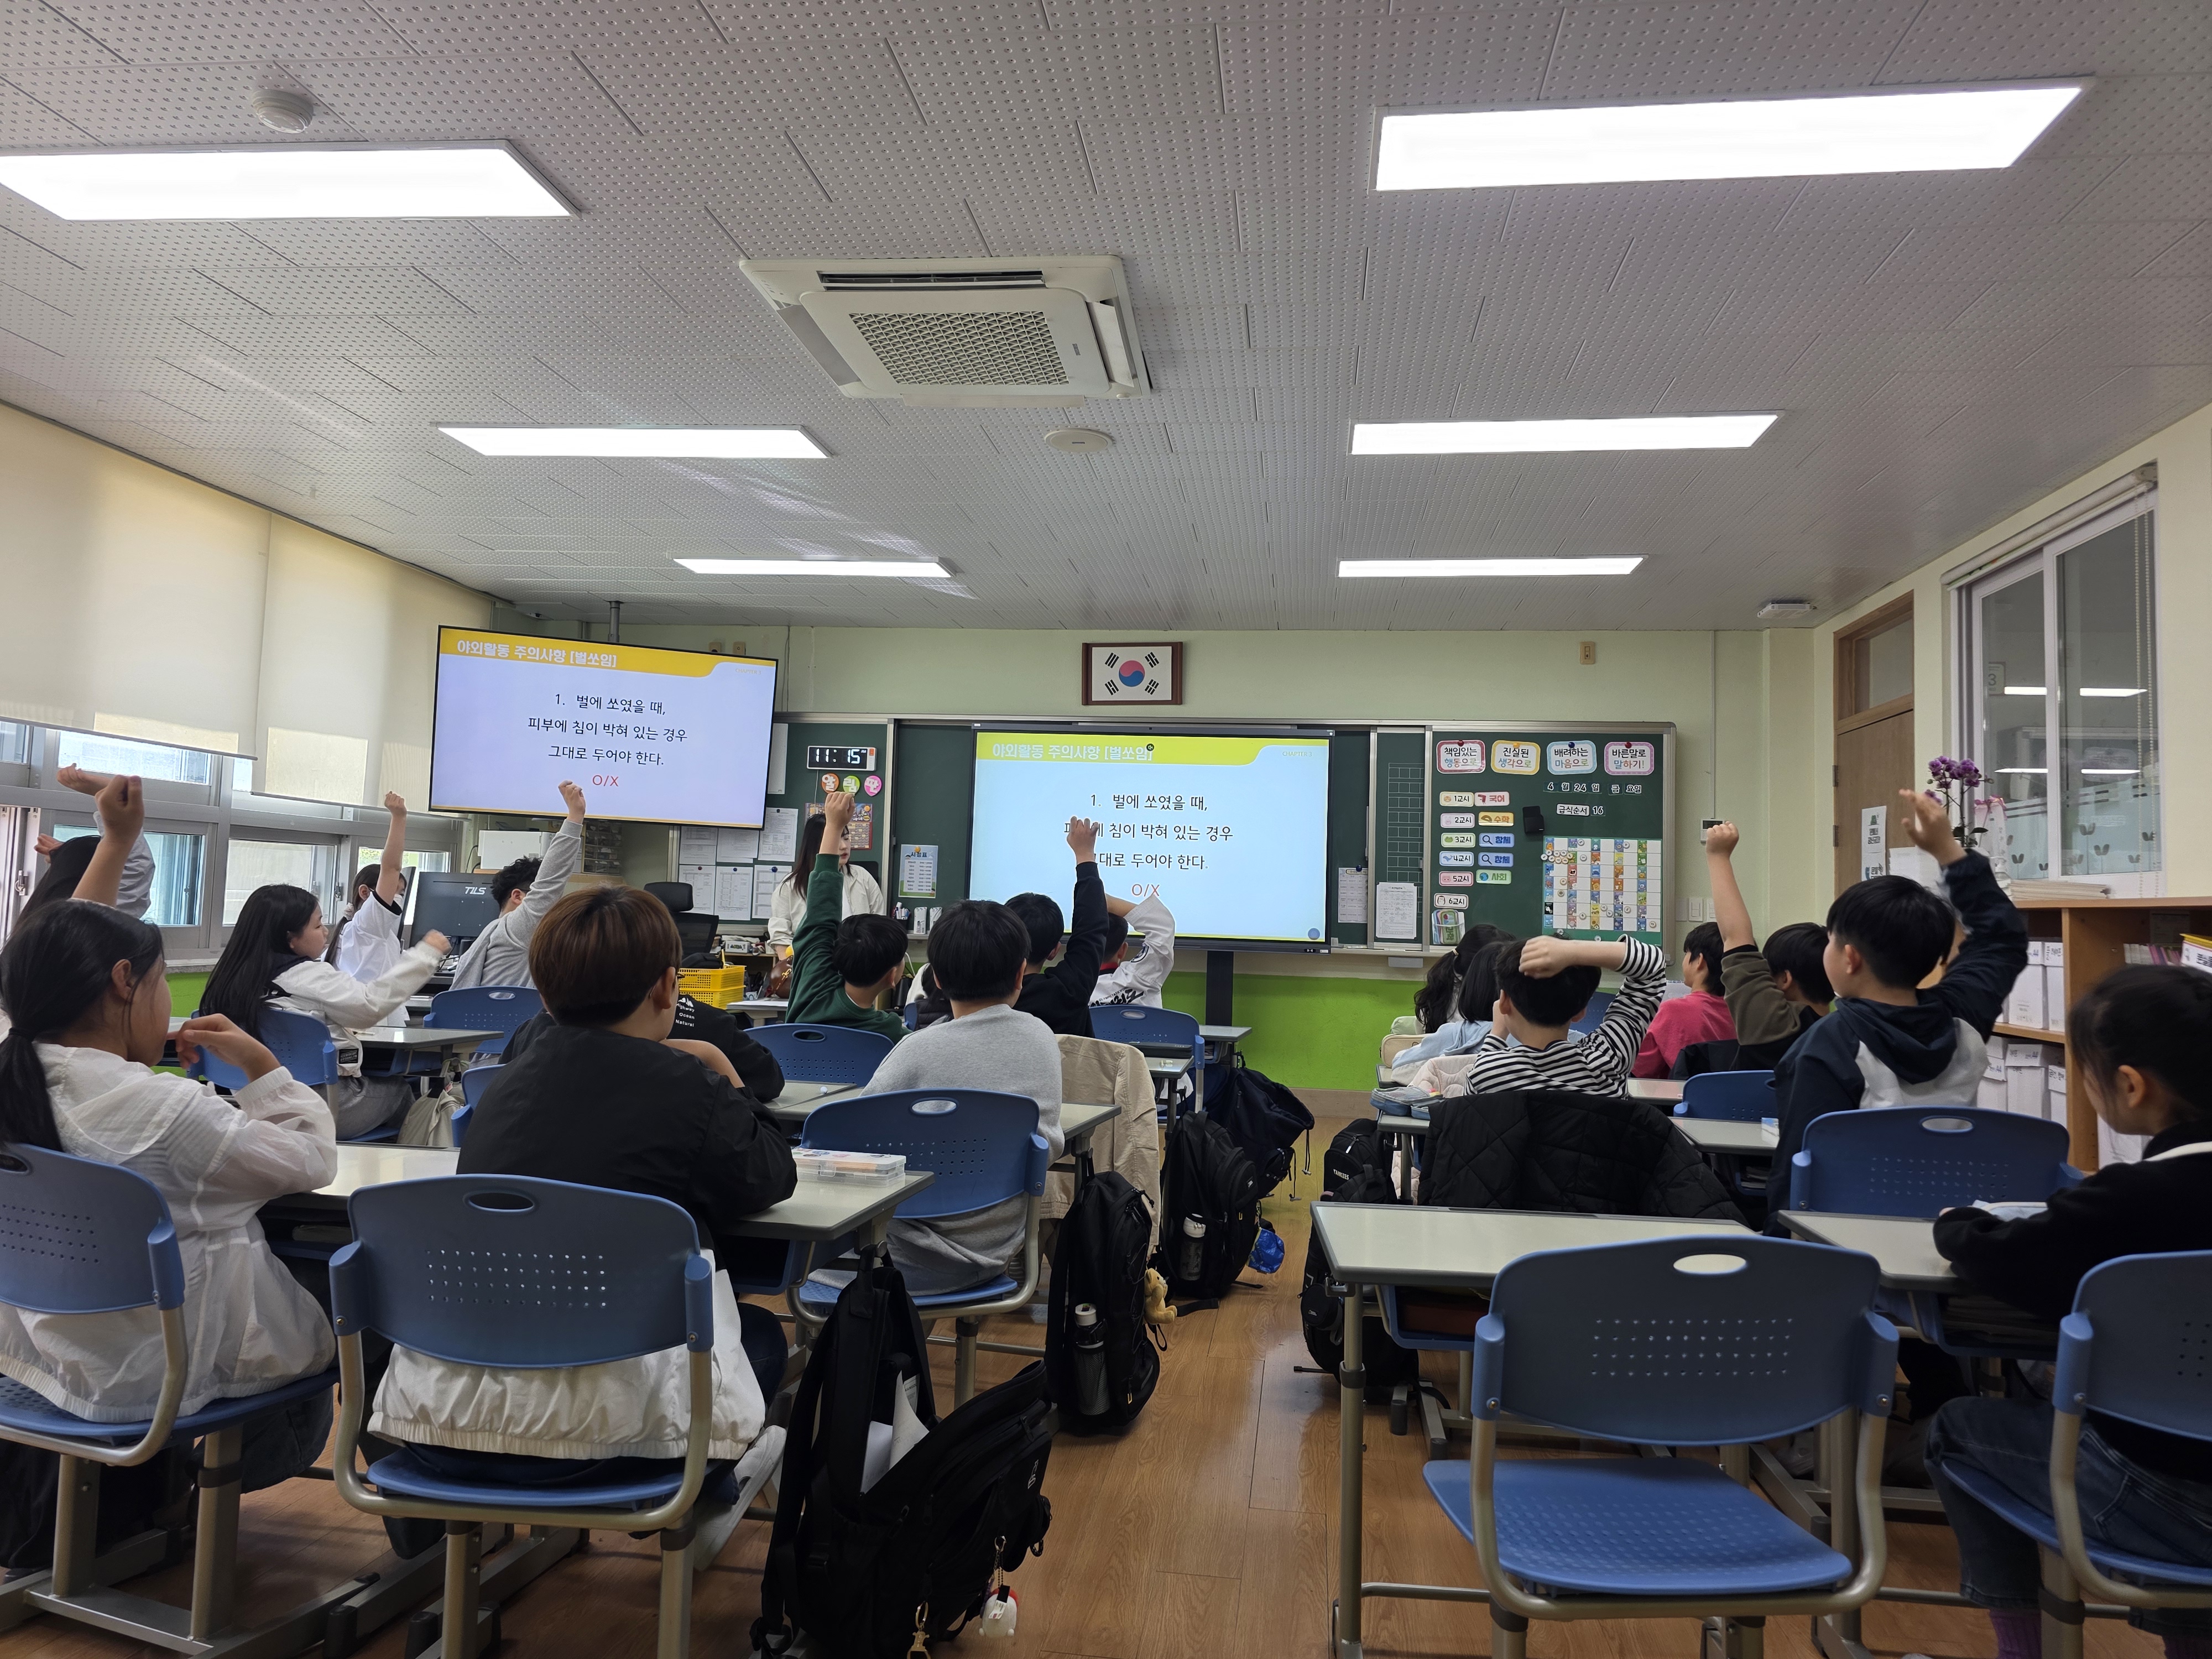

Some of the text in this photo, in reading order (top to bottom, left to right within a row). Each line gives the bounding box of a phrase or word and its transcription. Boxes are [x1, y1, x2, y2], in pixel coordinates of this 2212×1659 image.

[457, 640, 616, 668] 야외활동 주의사항 [벌쏘임]
[556, 694, 665, 715] 1. 벌에 쏘였을 때,
[528, 718, 687, 742] 피부에 침이 박혀 있는 경우
[549, 746, 663, 765] 그대로 두어야 한다.
[816, 748, 860, 764] 11:15
[992, 744, 1044, 759] 야외활동
[1047, 745, 1100, 760] 주의사항
[1443, 747, 1478, 757] 책임있는
[1503, 747, 1530, 758] 진실된
[1553, 747, 1589, 757] 배려하는
[1611, 748, 1647, 758] 바른말로
[1444, 758, 1478, 768] 행동으로
[1498, 758, 1532, 769] 생각으로
[1554, 759, 1589, 769] 마음으로
[1613, 759, 1645, 769] 말하기!
[593, 775, 618, 786] O/X
[1091, 795, 1207, 811] 1. 벌에 쏘였을 때,
[1454, 794, 1505, 803] 1교시 국어
[1558, 806, 1604, 815] 급식순서 16
[1494, 815, 1510, 823] 수학
[1109, 823, 1135, 838] 침이
[1142, 825, 1167, 839] 박혀
[1174, 826, 1200, 840] 있는
[1207, 827, 1233, 841] 경우
[1454, 836, 1511, 844] 3교시 창체
[1094, 852, 1209, 870] 대로 두어야 한다.
[1494, 855, 1510, 864] 창체
[1453, 872, 1507, 883] 5교시 사회
[1132, 884, 1160, 896] O/X
[1333, 1168, 1349, 1181] YANKEES
